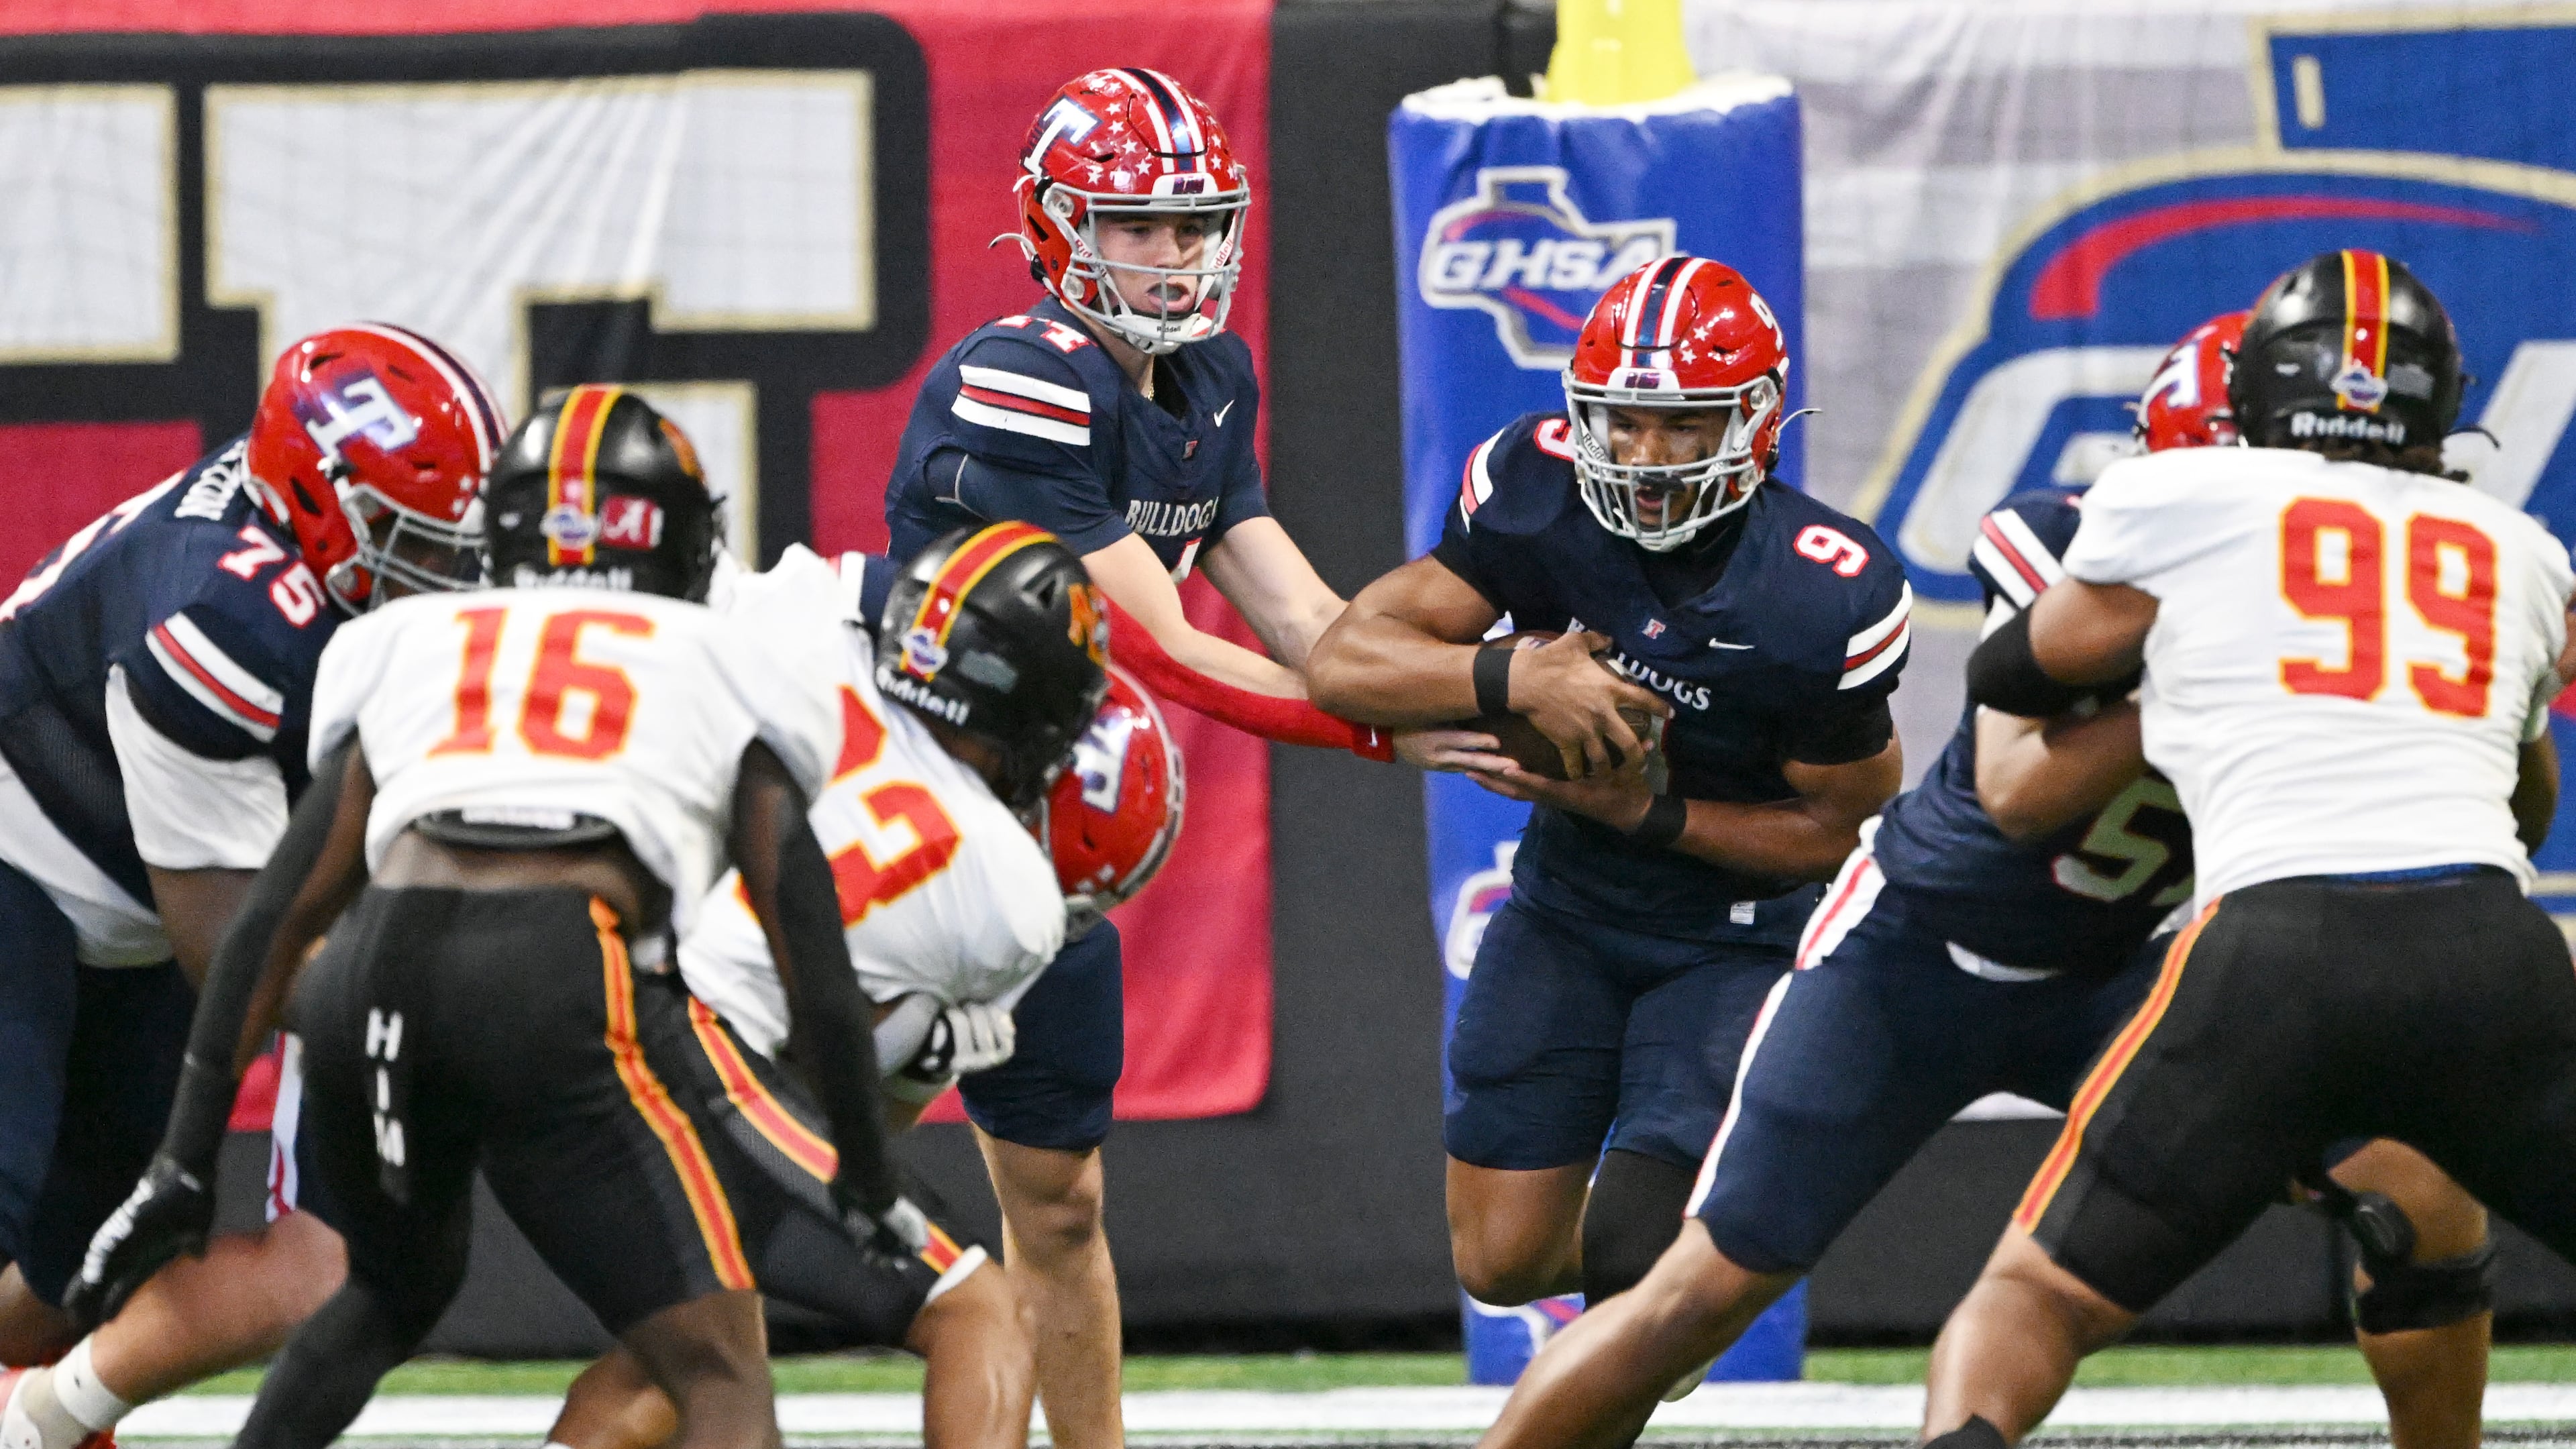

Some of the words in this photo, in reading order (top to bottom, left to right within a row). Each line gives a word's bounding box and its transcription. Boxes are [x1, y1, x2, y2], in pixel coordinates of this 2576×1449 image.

[1124, 496, 1220, 537] BULLDOG
[1794, 524, 1870, 578] 9
[217, 525, 327, 629] 75
[2278, 496, 2498, 719] 99
[426, 606, 656, 766] 16
